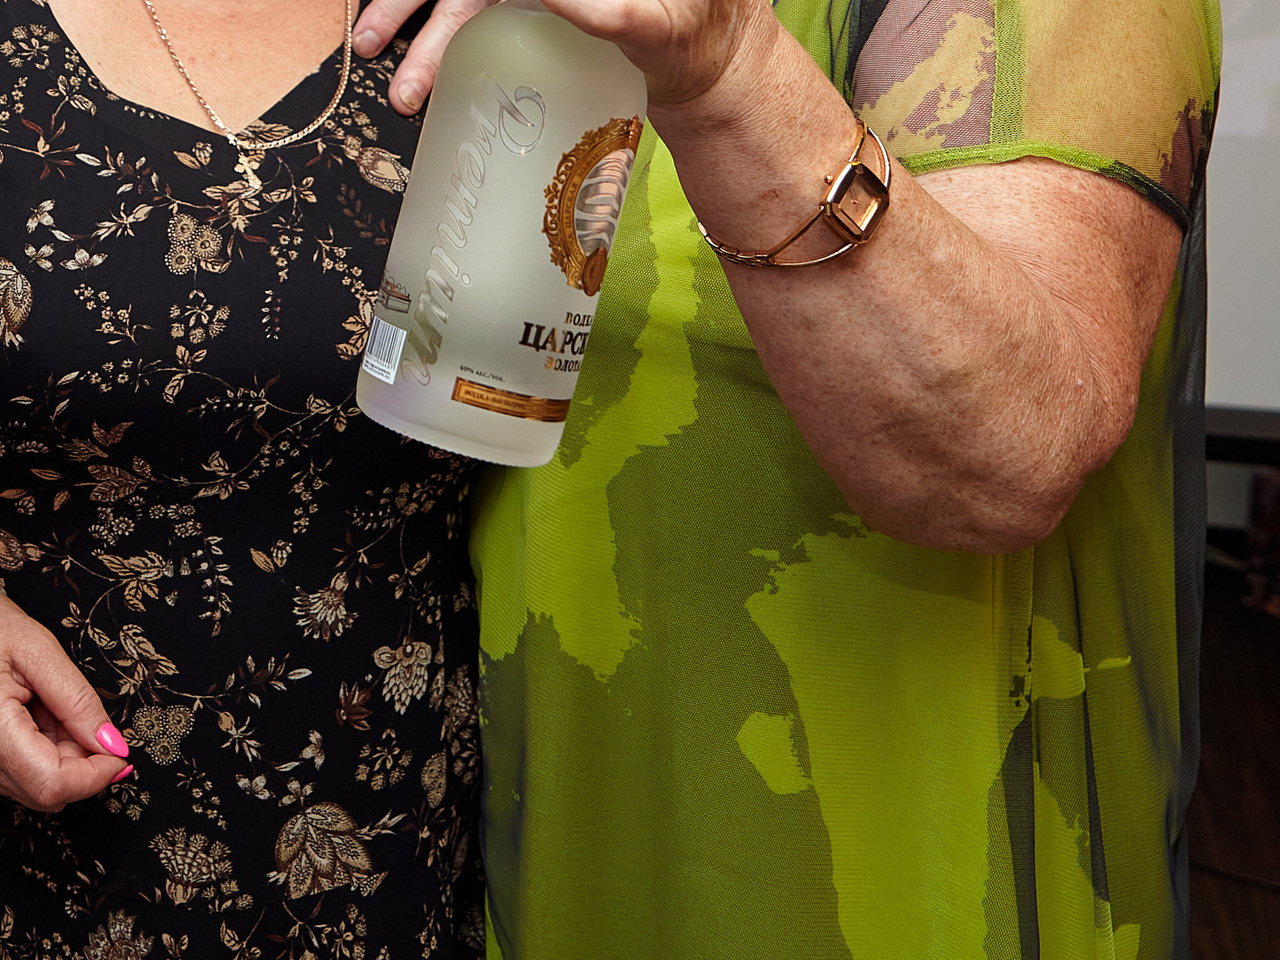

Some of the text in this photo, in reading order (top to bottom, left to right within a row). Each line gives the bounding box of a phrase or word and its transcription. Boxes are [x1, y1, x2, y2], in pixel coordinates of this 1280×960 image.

[401, 80, 546, 386] Premium
[459, 364, 475, 375] 40%
[544, 355, 581, 372] ЗОЛОТ
